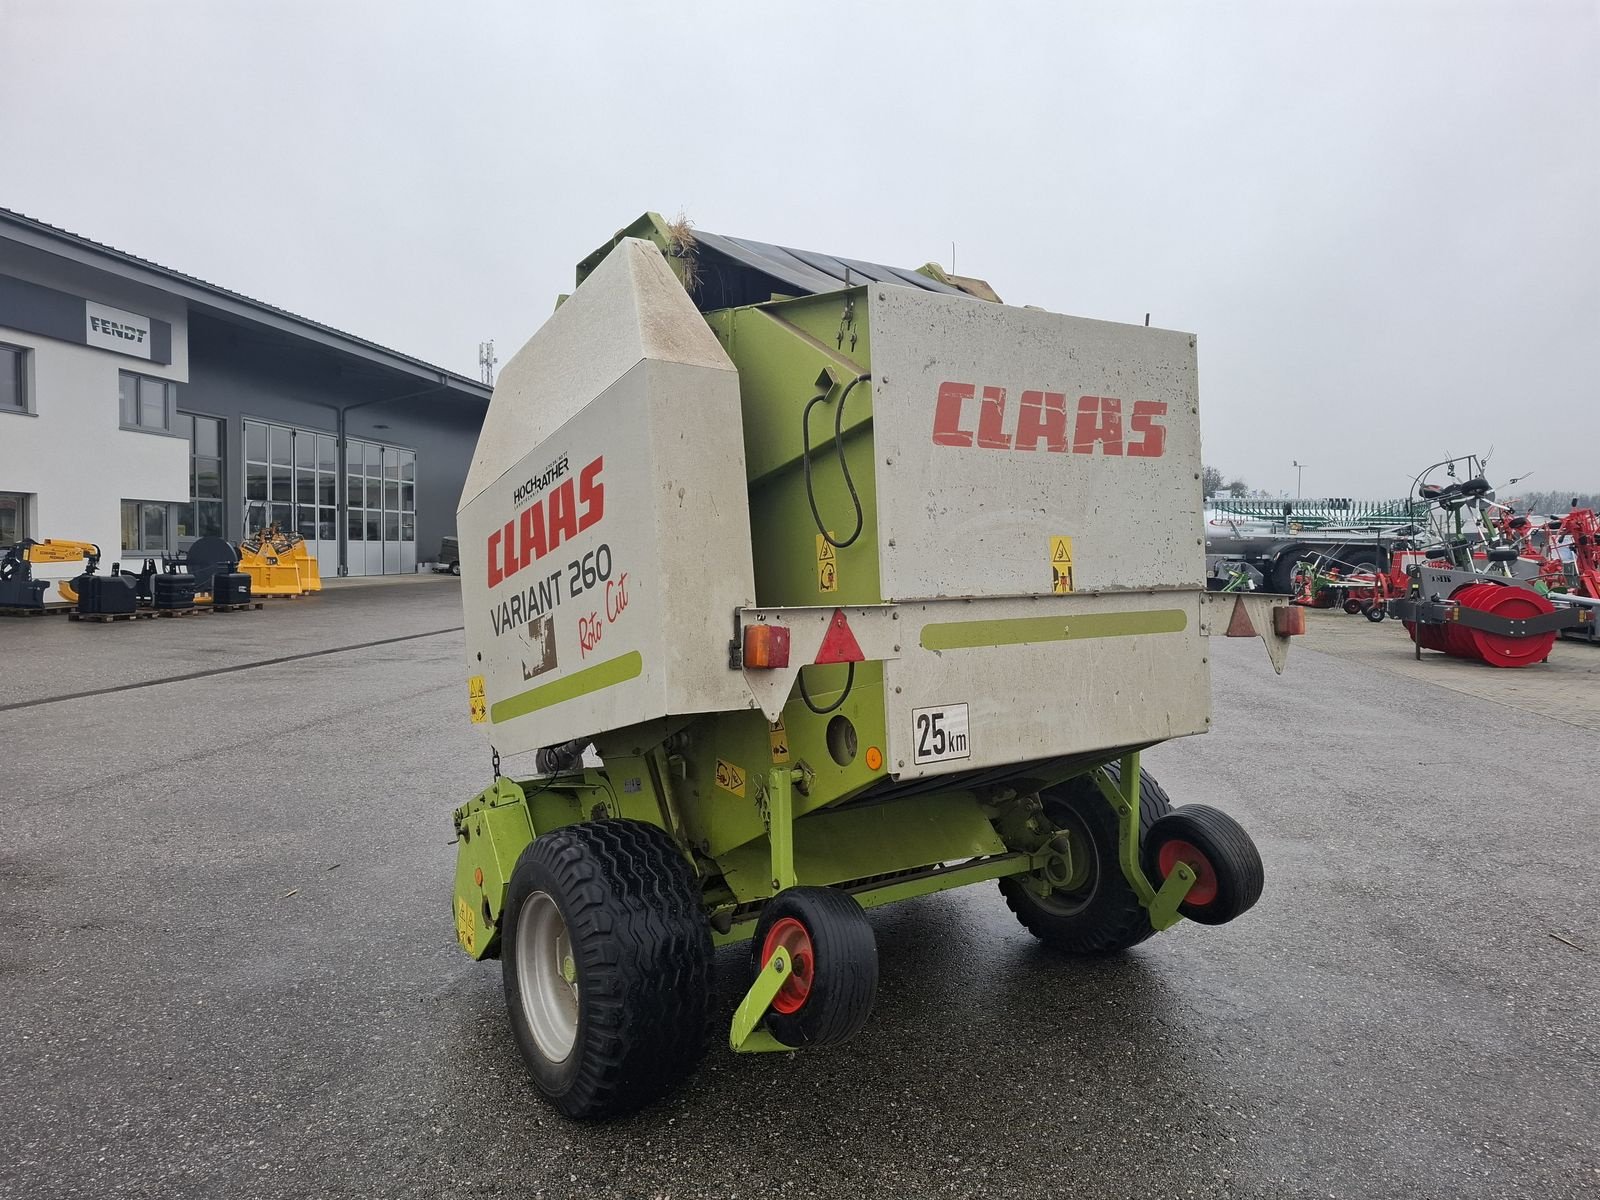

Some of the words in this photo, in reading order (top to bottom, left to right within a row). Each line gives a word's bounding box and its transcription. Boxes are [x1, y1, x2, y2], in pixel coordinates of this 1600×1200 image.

[90, 316, 147, 343] FENDT
[932, 381, 1168, 458] CLAAS
[487, 455, 604, 589] CLAAS
[490, 569, 562, 637] VARIANT
[568, 543, 612, 598] 260
[578, 611, 603, 660] Roto
[605, 572, 629, 623] Cut
[917, 712, 946, 757] 25
[948, 730, 967, 753] km
